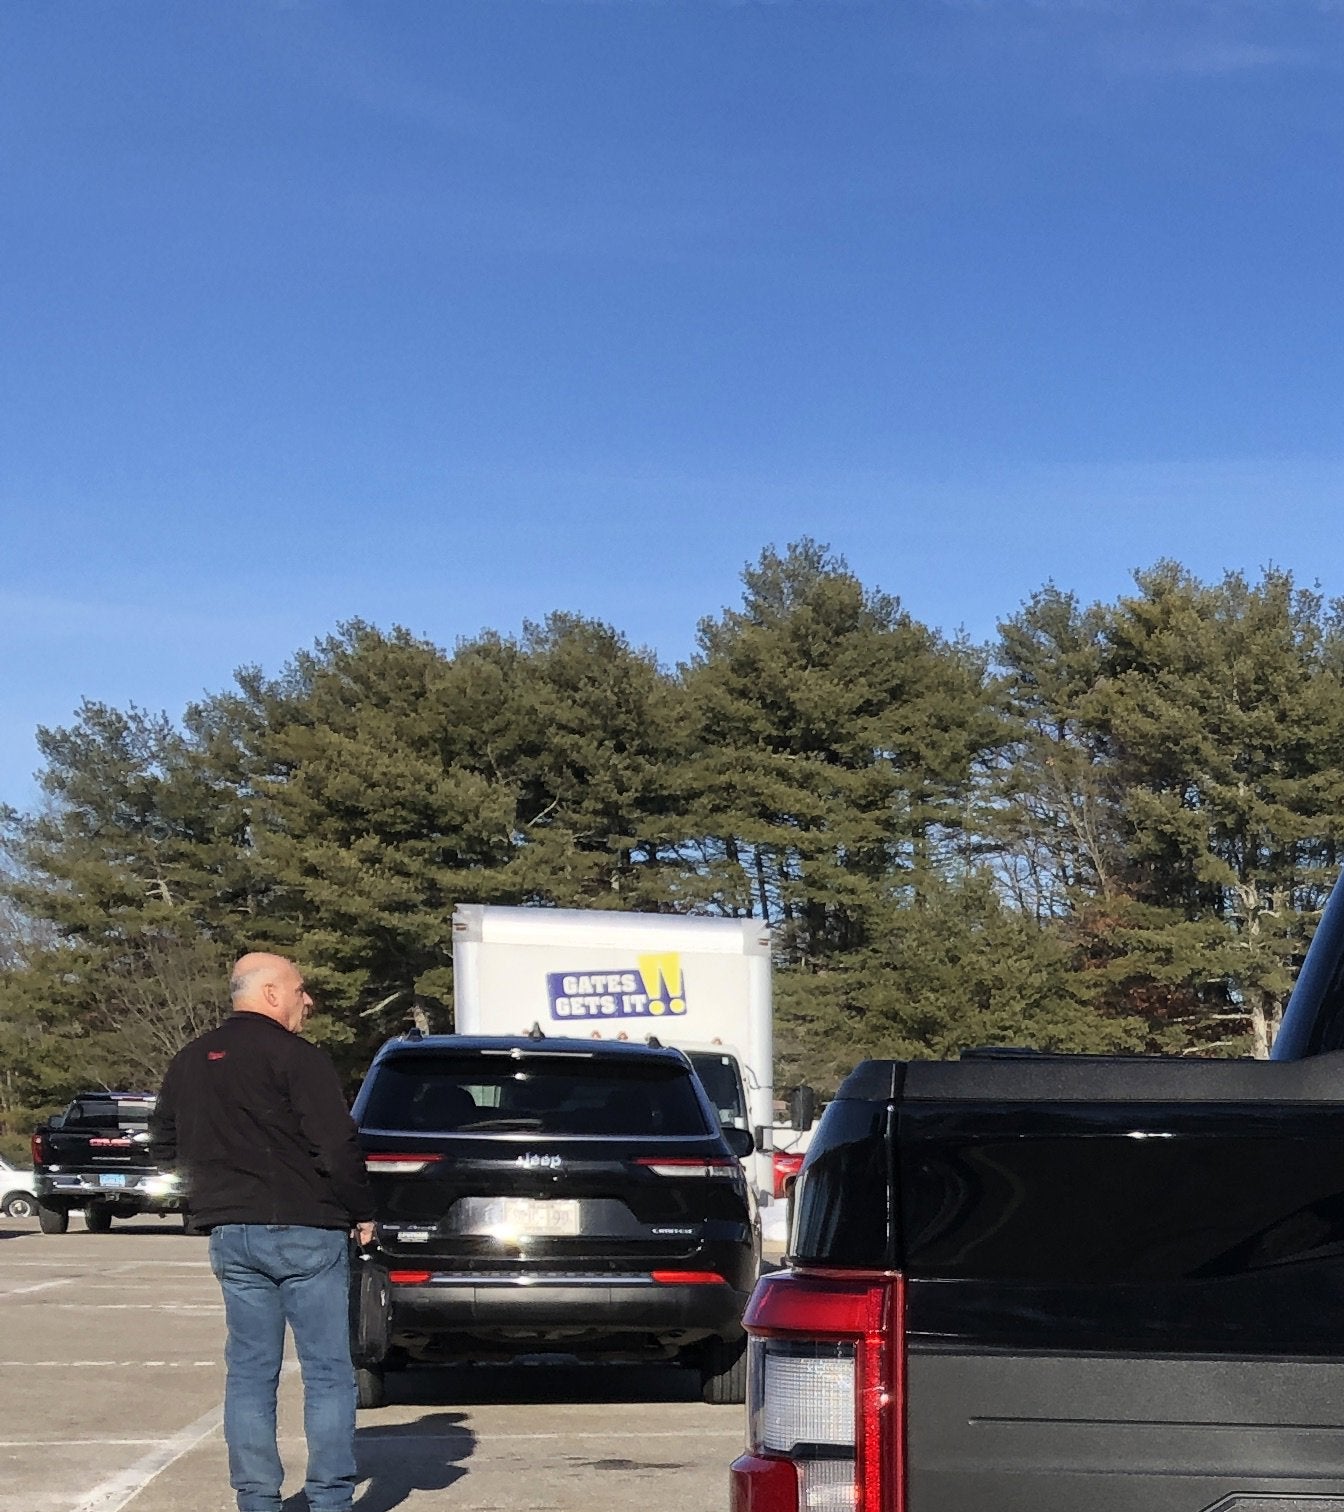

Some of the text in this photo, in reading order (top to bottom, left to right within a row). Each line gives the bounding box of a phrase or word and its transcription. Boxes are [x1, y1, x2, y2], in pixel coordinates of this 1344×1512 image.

[562, 974, 637, 995] GATES
[555, 995, 616, 1017] GETS
[519, 1152, 562, 1169] Jeep
